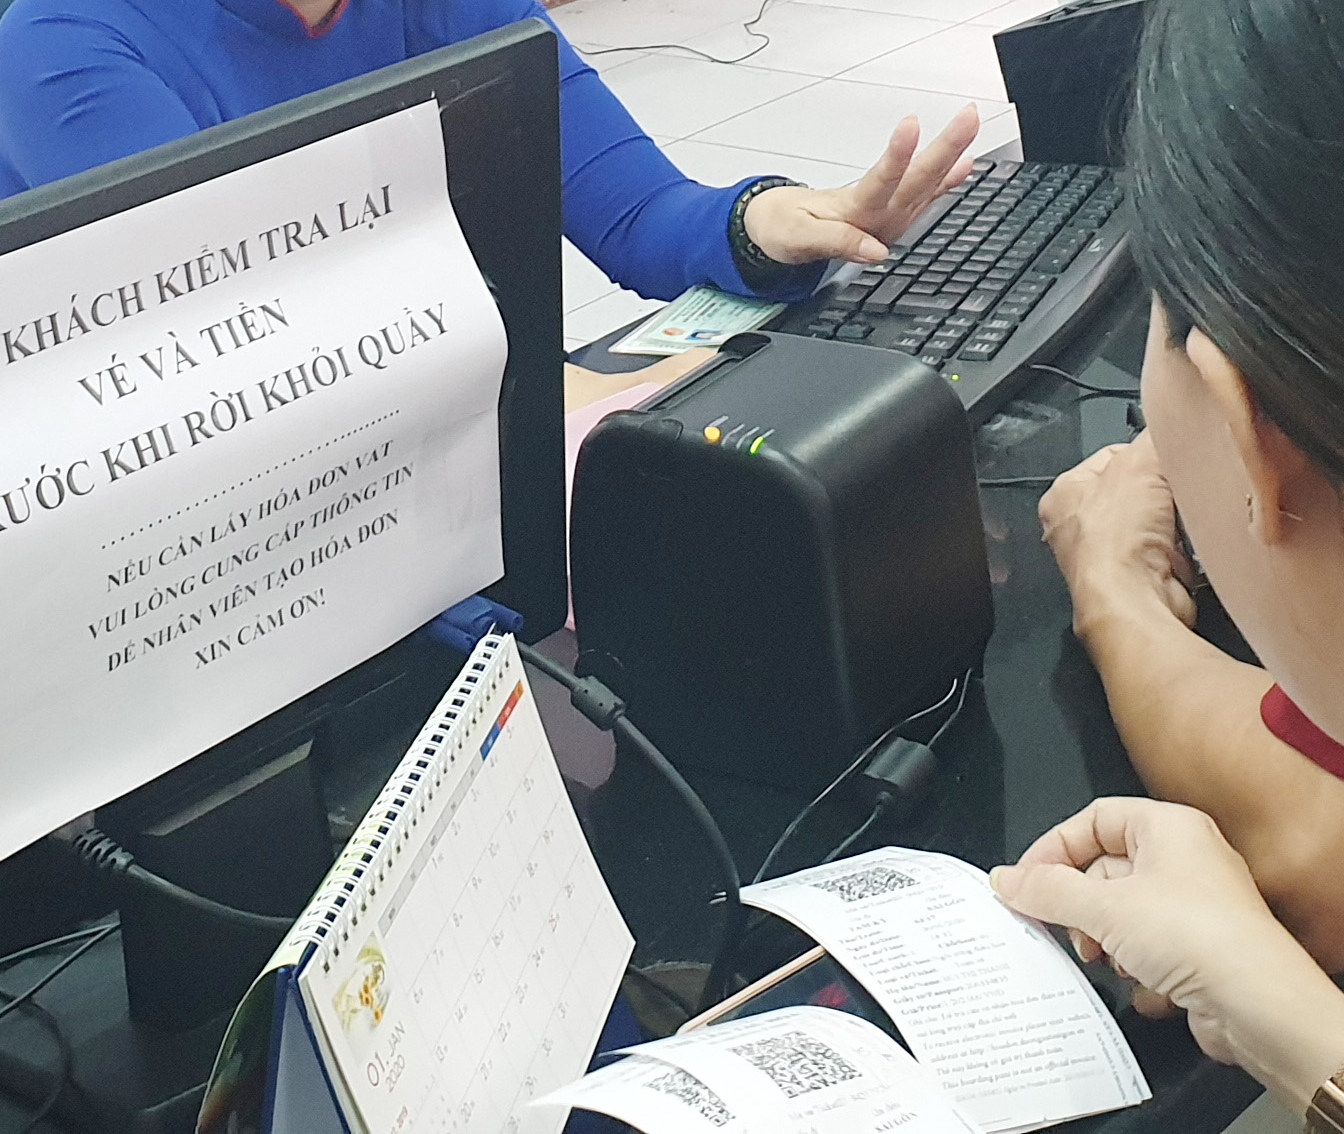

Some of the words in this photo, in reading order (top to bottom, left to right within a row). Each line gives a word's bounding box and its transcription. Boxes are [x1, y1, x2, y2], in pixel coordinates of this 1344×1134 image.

[2, 279, 147, 365] KHÁCH
[154, 244, 252, 305] KIỂM
[258, 212, 330, 262] TRA
[336, 183, 394, 230] LẠI
[77, 353, 137, 407] VÉ
[138, 330, 200, 381] VÀ
[199, 298, 290, 358] TIỀN
[99, 423, 179, 483] KHI
[181, 389, 255, 447] RỜI
[256, 346, 354, 413] KHỎI
[257, 486, 302, 520] HÓA
[355, 439, 395, 470] VAT
[87, 607, 128, 640] VUI
[134, 574, 196, 619] LÒNG
[201, 543, 261, 585] CUNG
[310, 481, 378, 530] THÔNG
[382, 462, 415, 492] TIN
[142, 608, 203, 655] NHÂN
[209, 580, 258, 618] VIÊN
[262, 557, 305, 591] TẠO
[310, 534, 353, 568] HÓA
[193, 634, 233, 670] XIN
[290, 587, 327, 619] ƠN!
[367, 1050, 390, 1087] 01.
[390, 1020, 406, 1058] JAN
[385, 1053, 406, 1094] 2020
